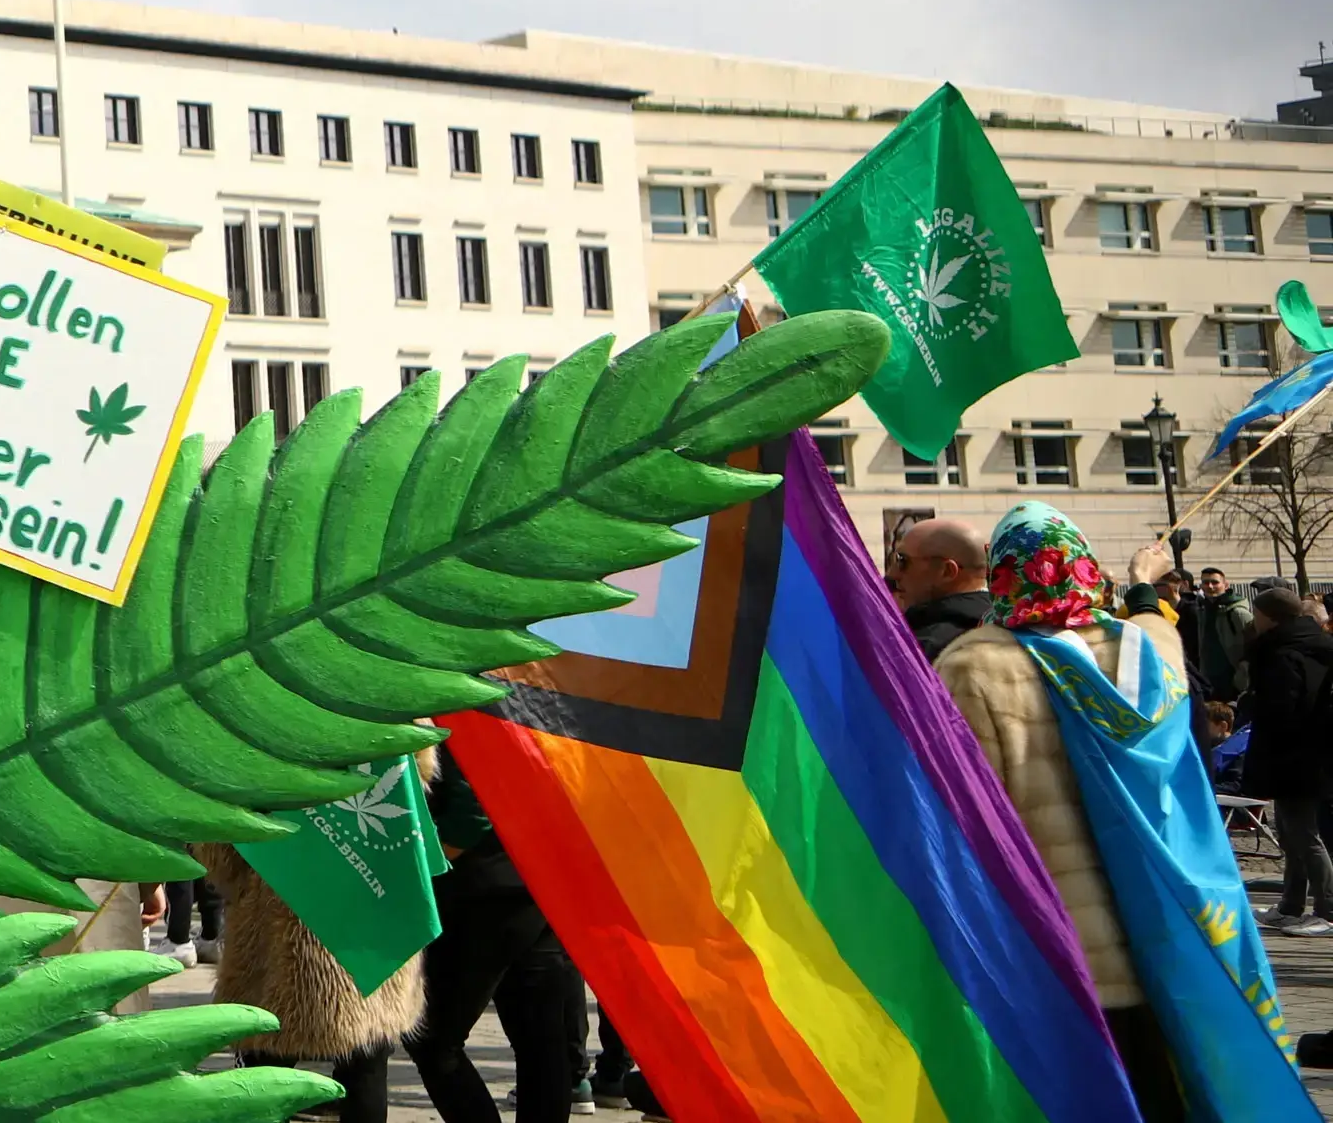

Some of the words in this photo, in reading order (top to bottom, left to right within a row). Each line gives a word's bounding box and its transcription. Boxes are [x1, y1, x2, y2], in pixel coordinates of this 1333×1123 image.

[861, 261, 943, 388] WWW.CSC.BERLIN
[915, 207, 1012, 298] LEGALIZE
[967, 307, 1000, 342] IT
[301, 806, 386, 899] .CSC.BERLIN
